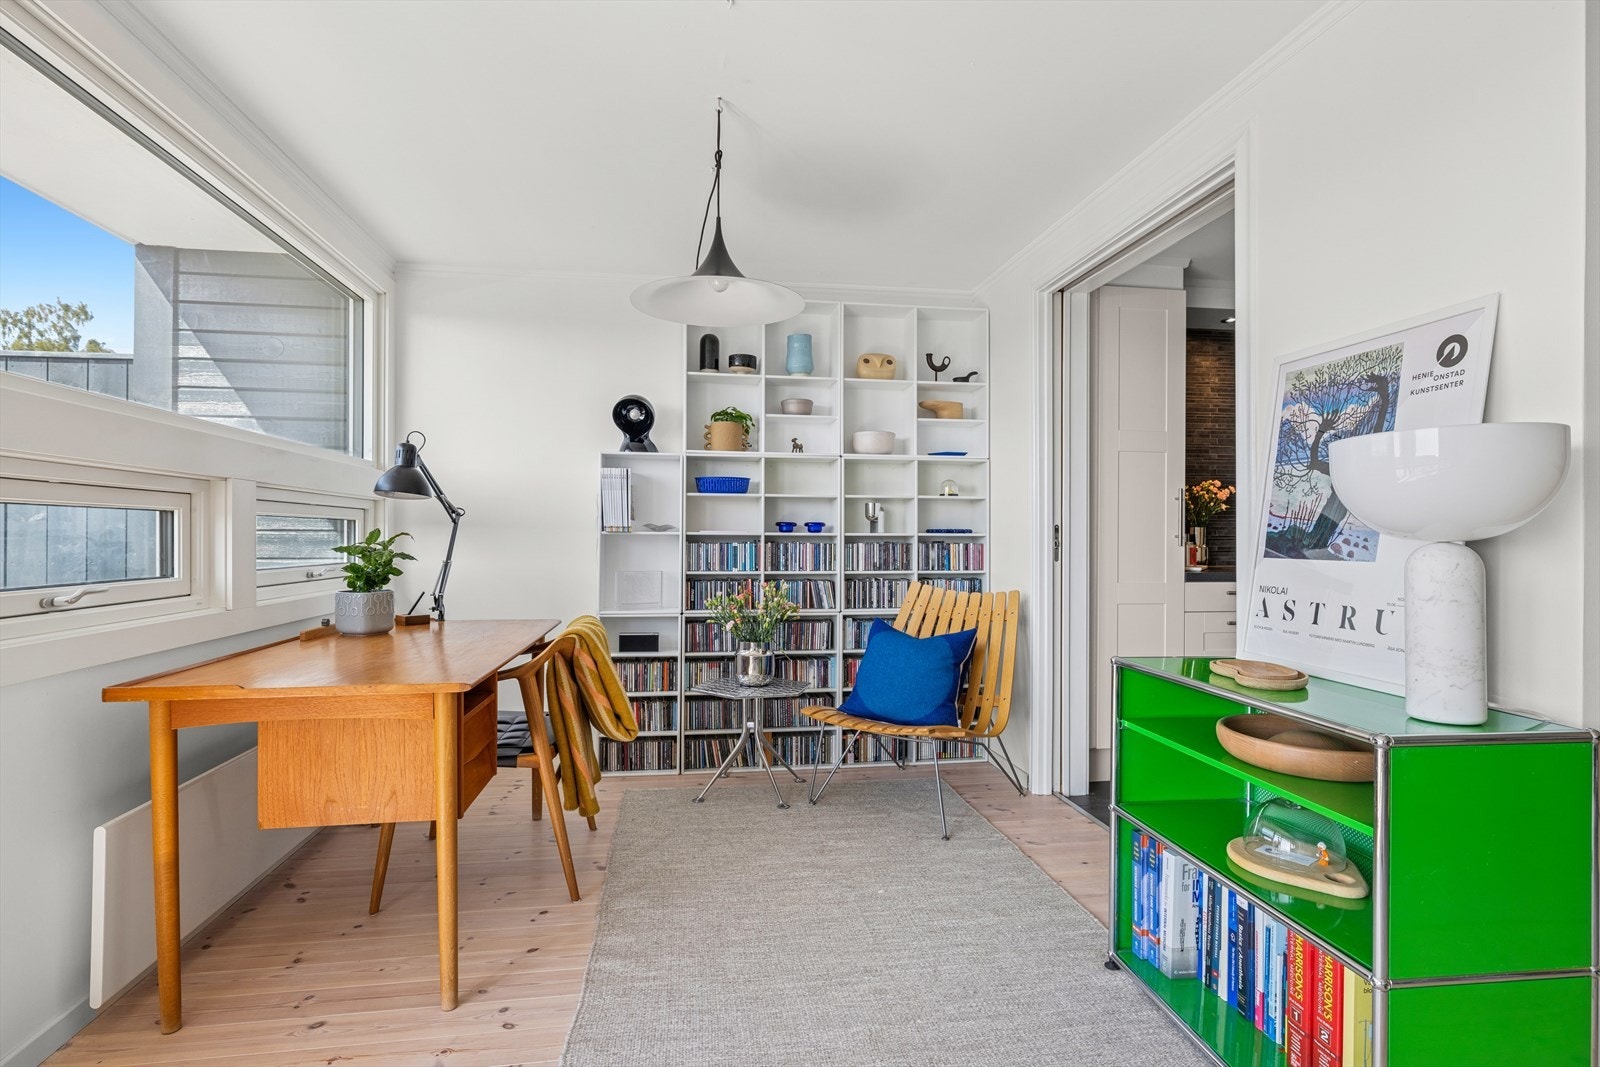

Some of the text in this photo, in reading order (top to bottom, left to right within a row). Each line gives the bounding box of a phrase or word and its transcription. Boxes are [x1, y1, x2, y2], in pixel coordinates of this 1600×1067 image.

[1412, 369, 1466, 382] HENIE ONSTAD
[1410, 379, 1464, 396] KUNSTSENTER
[1259, 585, 1289, 595] NIKOLAI
[1255, 597, 1396, 636] ASTRU
[1182, 863, 1198, 880] Fra
[1295, 934, 1304, 1000] HARRISON'S
[1323, 956, 1333, 1022] HARRISON'S
